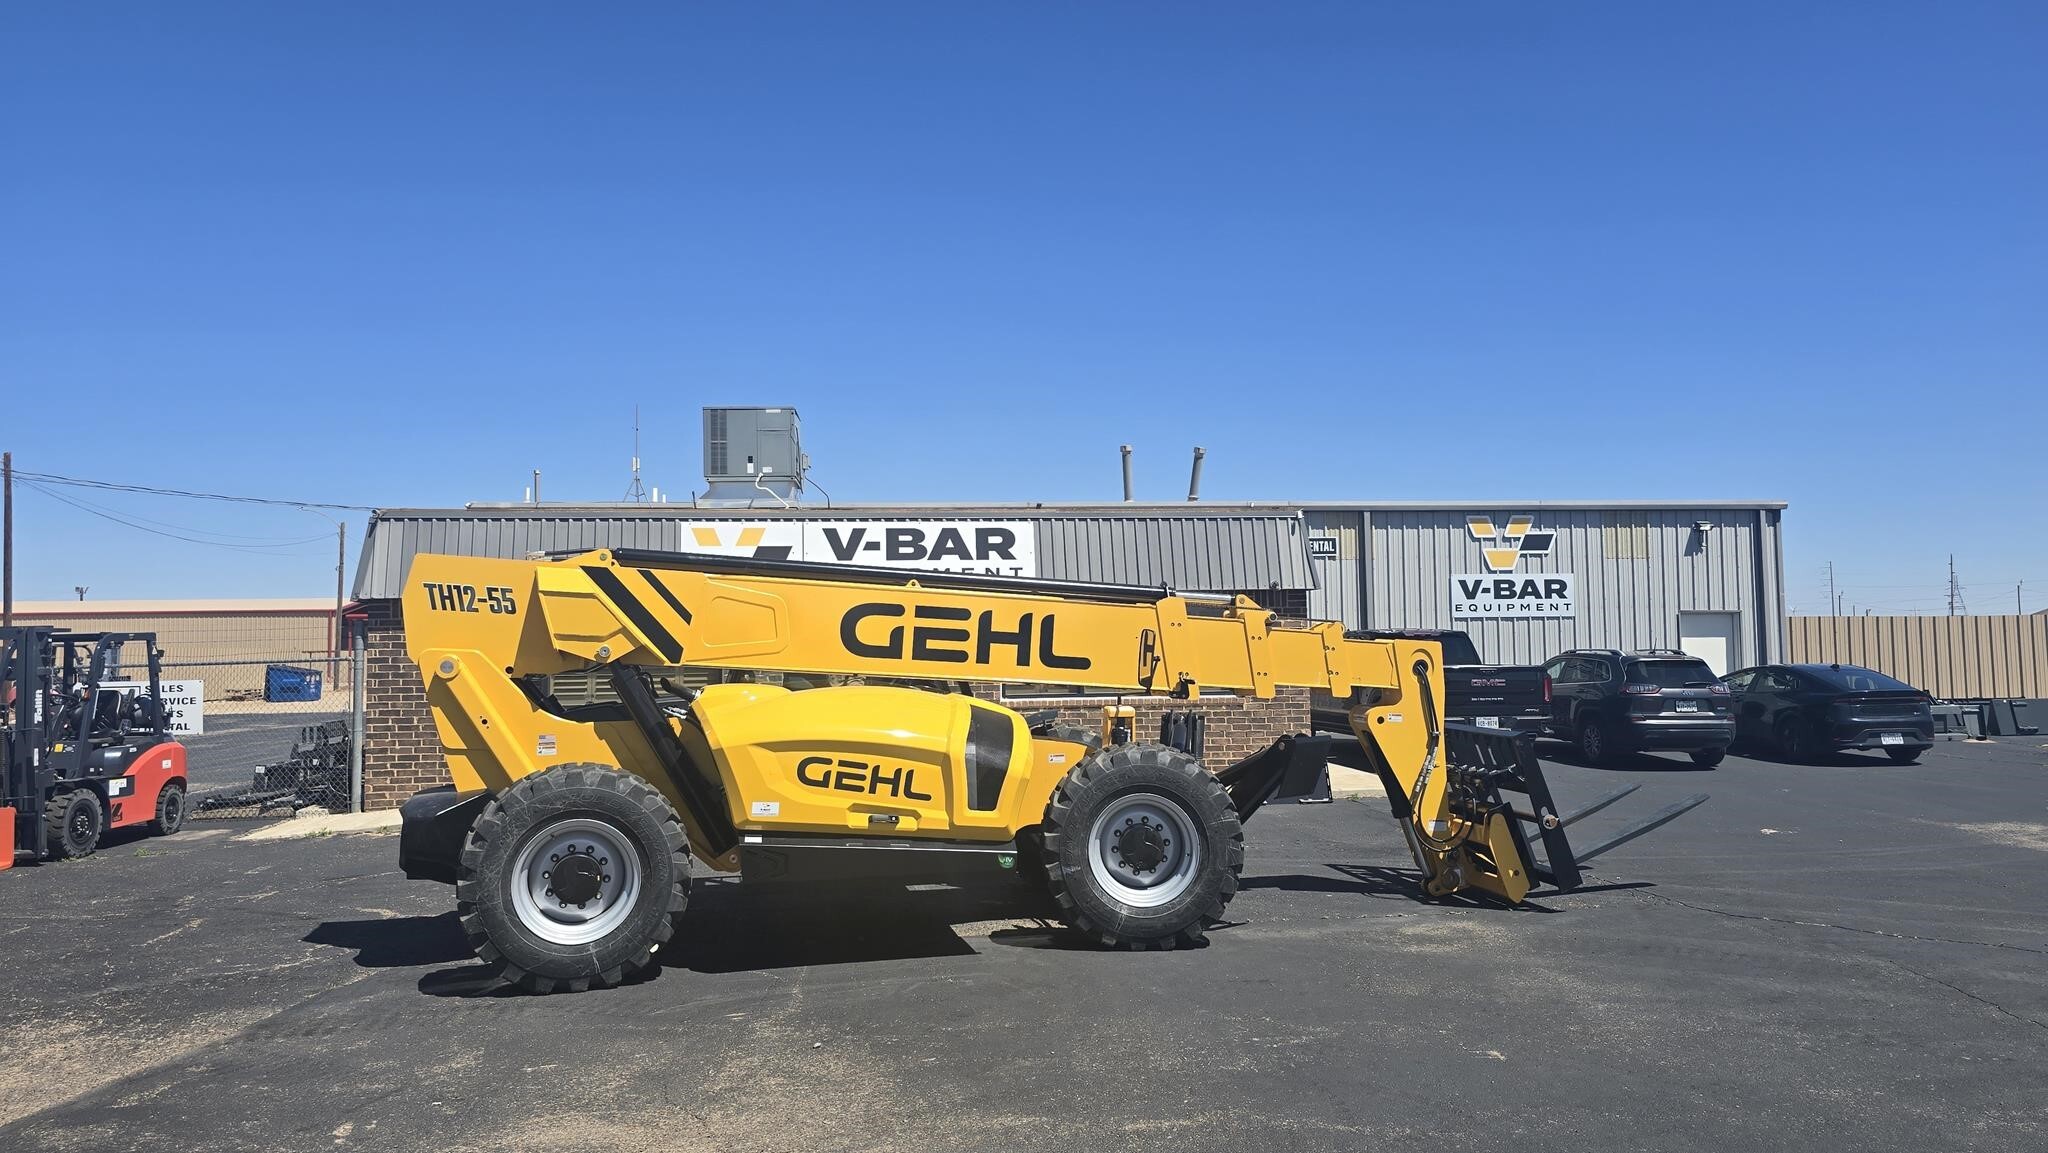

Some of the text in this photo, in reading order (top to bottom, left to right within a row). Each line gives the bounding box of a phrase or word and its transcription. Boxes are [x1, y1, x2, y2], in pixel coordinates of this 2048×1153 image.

[822, 528, 1016, 561] V-BAR
[1310, 541, 1335, 551] ENTAL
[422, 582, 517, 615] TH12-55
[1458, 579, 1568, 600] V-BAR
[1455, 603, 1572, 613] EQUIPMENT
[840, 602, 1092, 670] GEHL
[145, 684, 184, 693] SLES
[161, 697, 196, 705] RVICE
[797, 756, 932, 801] GEHL
